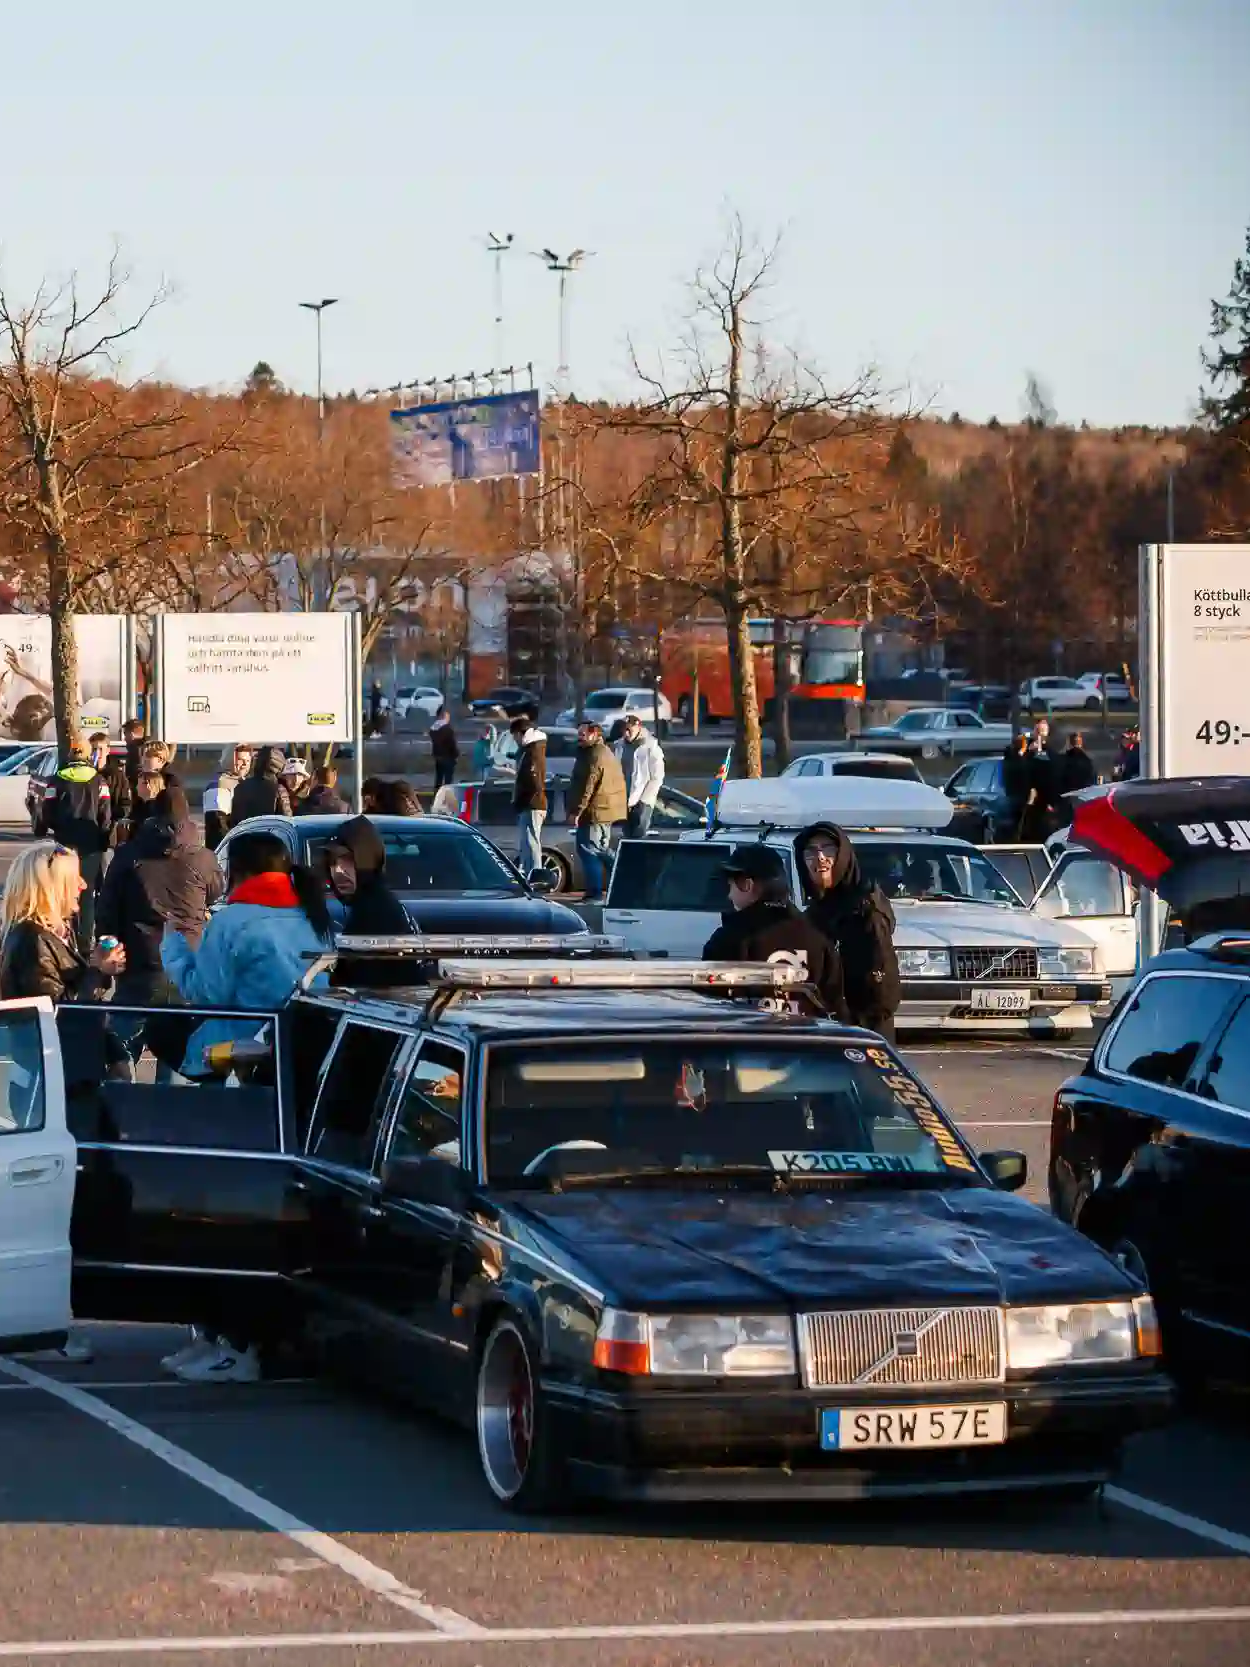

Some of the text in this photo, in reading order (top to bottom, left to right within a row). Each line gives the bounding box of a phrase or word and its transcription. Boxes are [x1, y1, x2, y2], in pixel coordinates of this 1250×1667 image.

[1193, 603, 1241, 620] 8 styck
[853, 1408, 990, 1443] SRW 57E
